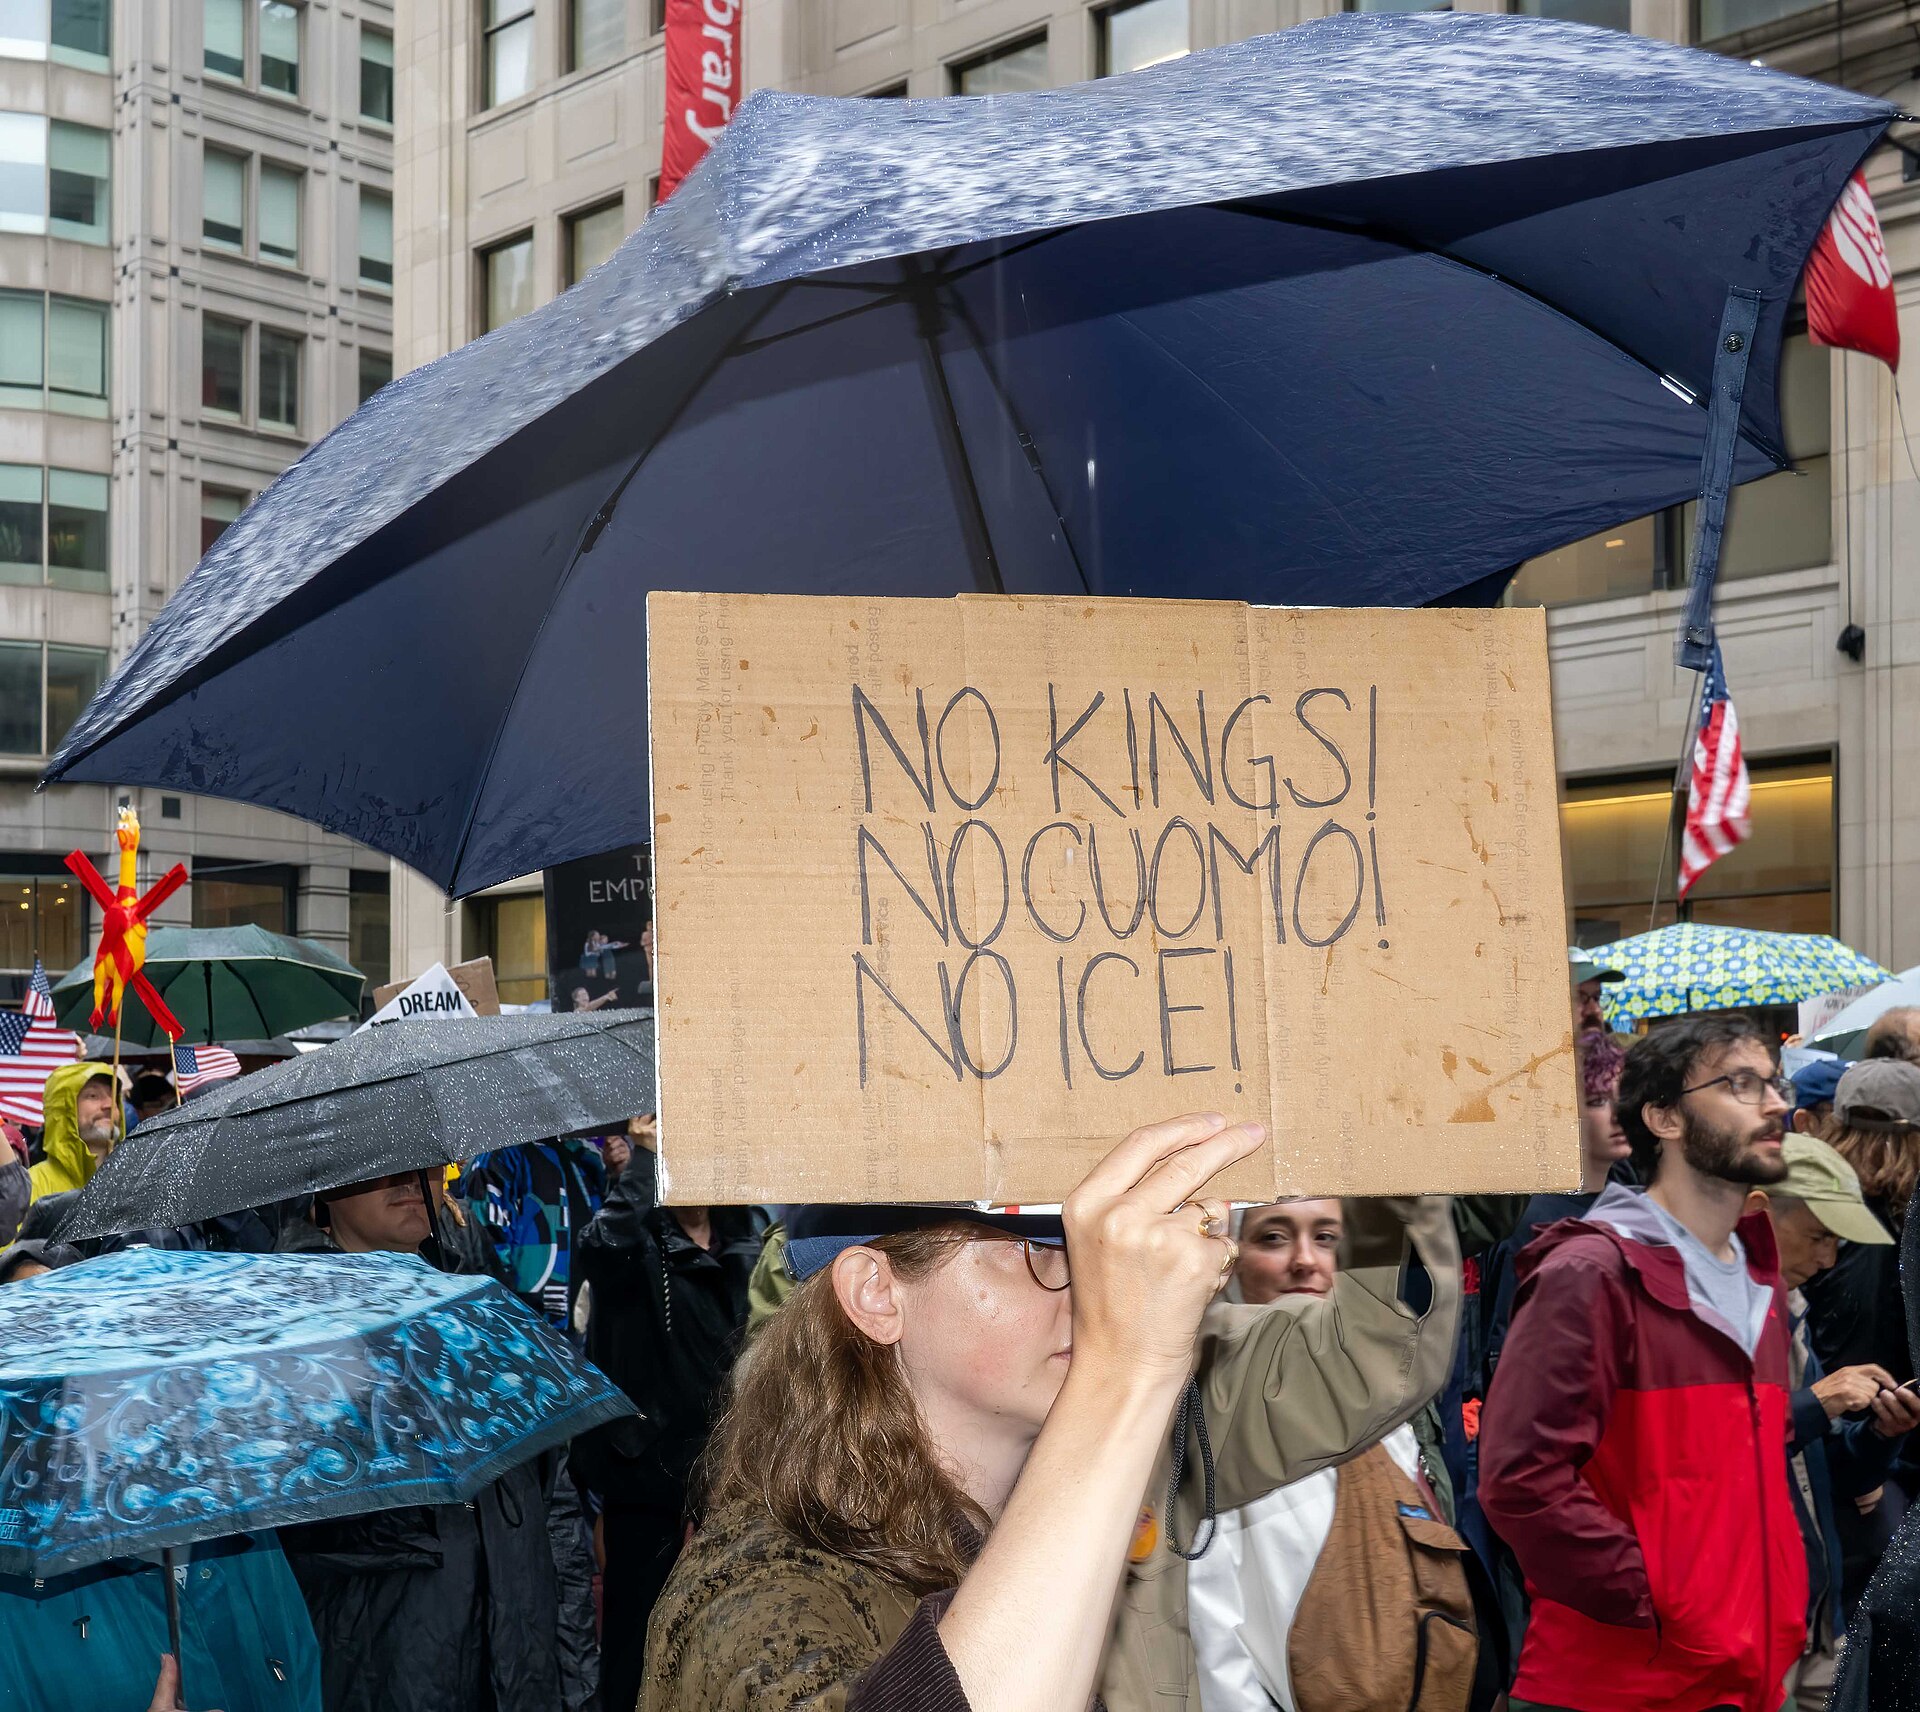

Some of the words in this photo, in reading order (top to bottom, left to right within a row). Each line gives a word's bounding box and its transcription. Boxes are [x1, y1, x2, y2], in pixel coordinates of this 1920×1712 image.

[716, 635, 734, 680] using
[1481, 628, 1499, 656] you
[718, 685, 732, 708] for
[721, 713, 737, 743] you
[718, 749, 735, 801] Thank
[852, 685, 1001, 813] NO
[1044, 684, 1378, 821] KINGS!
[698, 761, 716, 807] using
[857, 818, 1009, 949] NO
[1021, 815, 1389, 949] CUOMO!
[398, 990, 462, 1017] DREAM
[852, 947, 1018, 1089] NO
[1056, 946, 1243, 1093] ICE!
[706, 1066, 727, 1137] required
